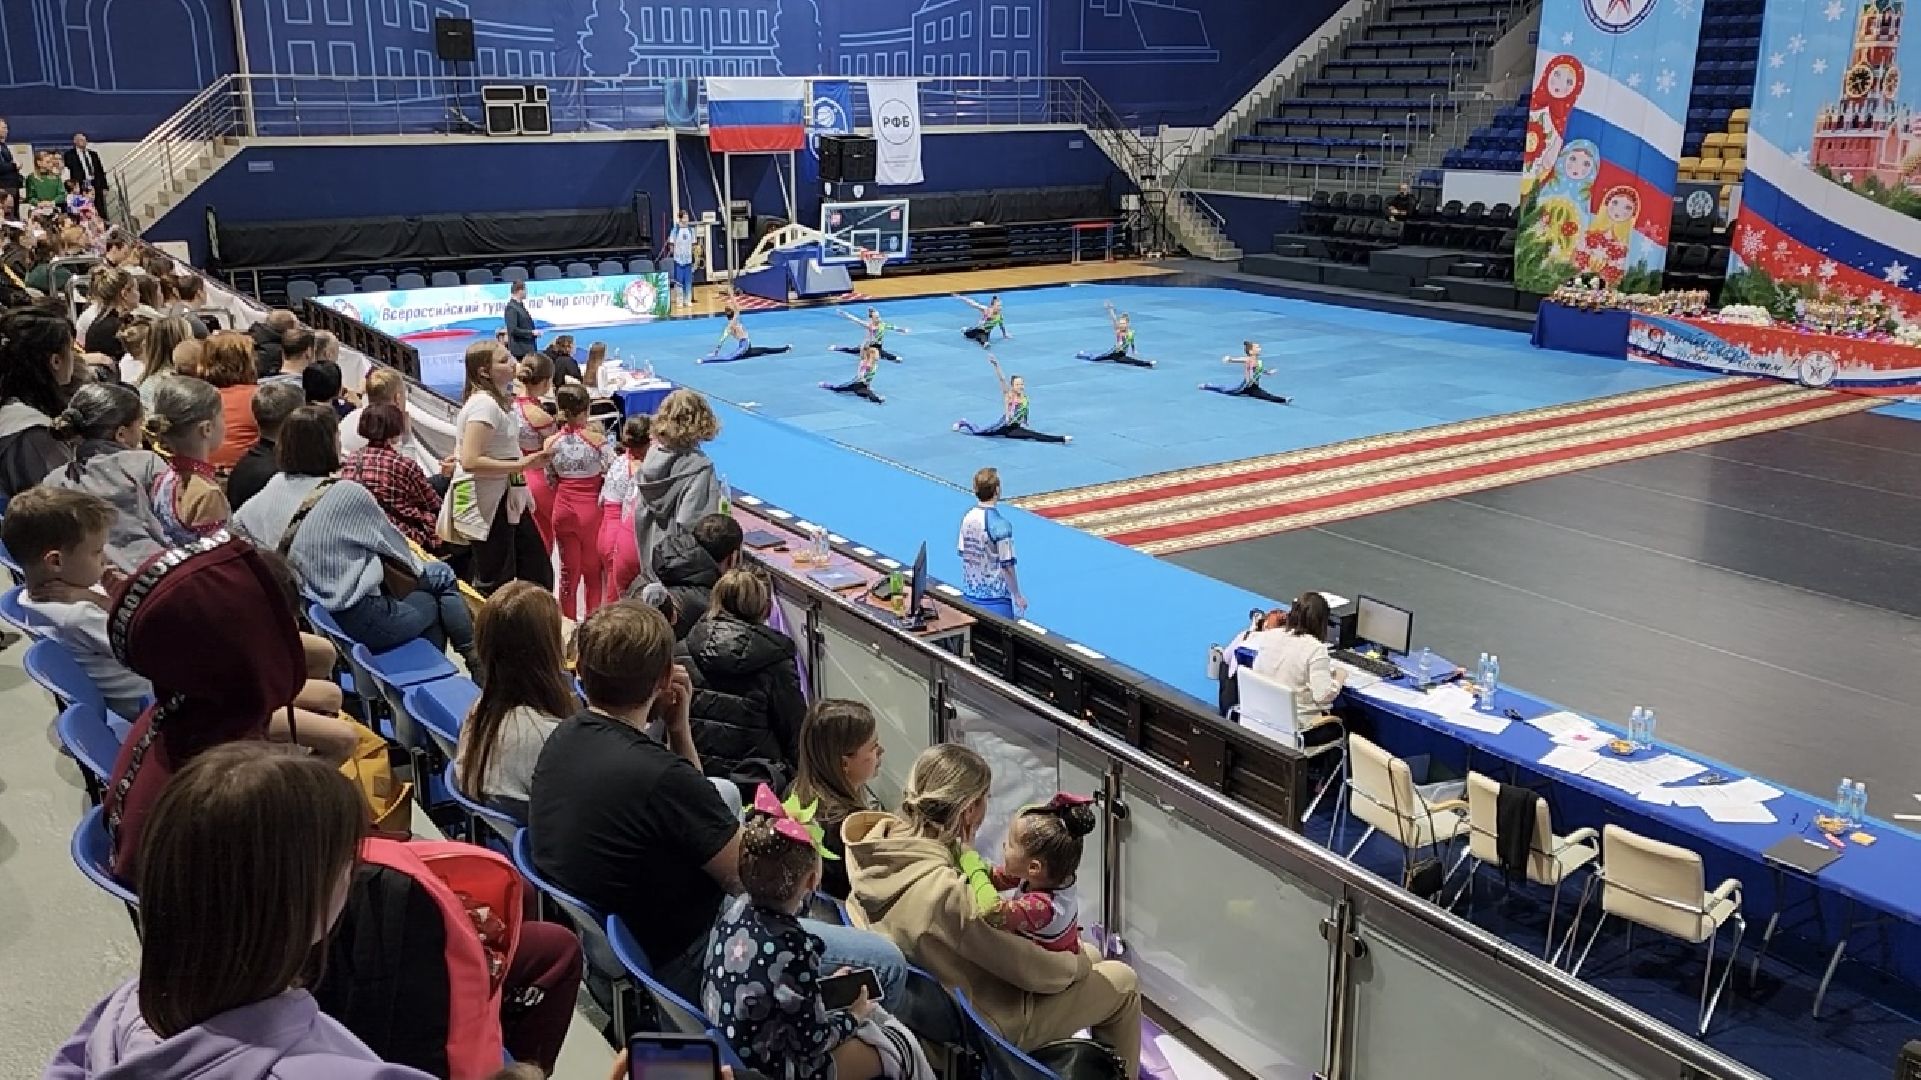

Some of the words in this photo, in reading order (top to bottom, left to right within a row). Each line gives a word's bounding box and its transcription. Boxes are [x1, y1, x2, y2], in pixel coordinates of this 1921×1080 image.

[883, 115, 910, 128] РФБ
[382, 301, 479, 322] Всероссийский
[528, 298, 543, 309] по
[547, 295, 569, 309] Чир
[573, 293, 612, 308] спорту
